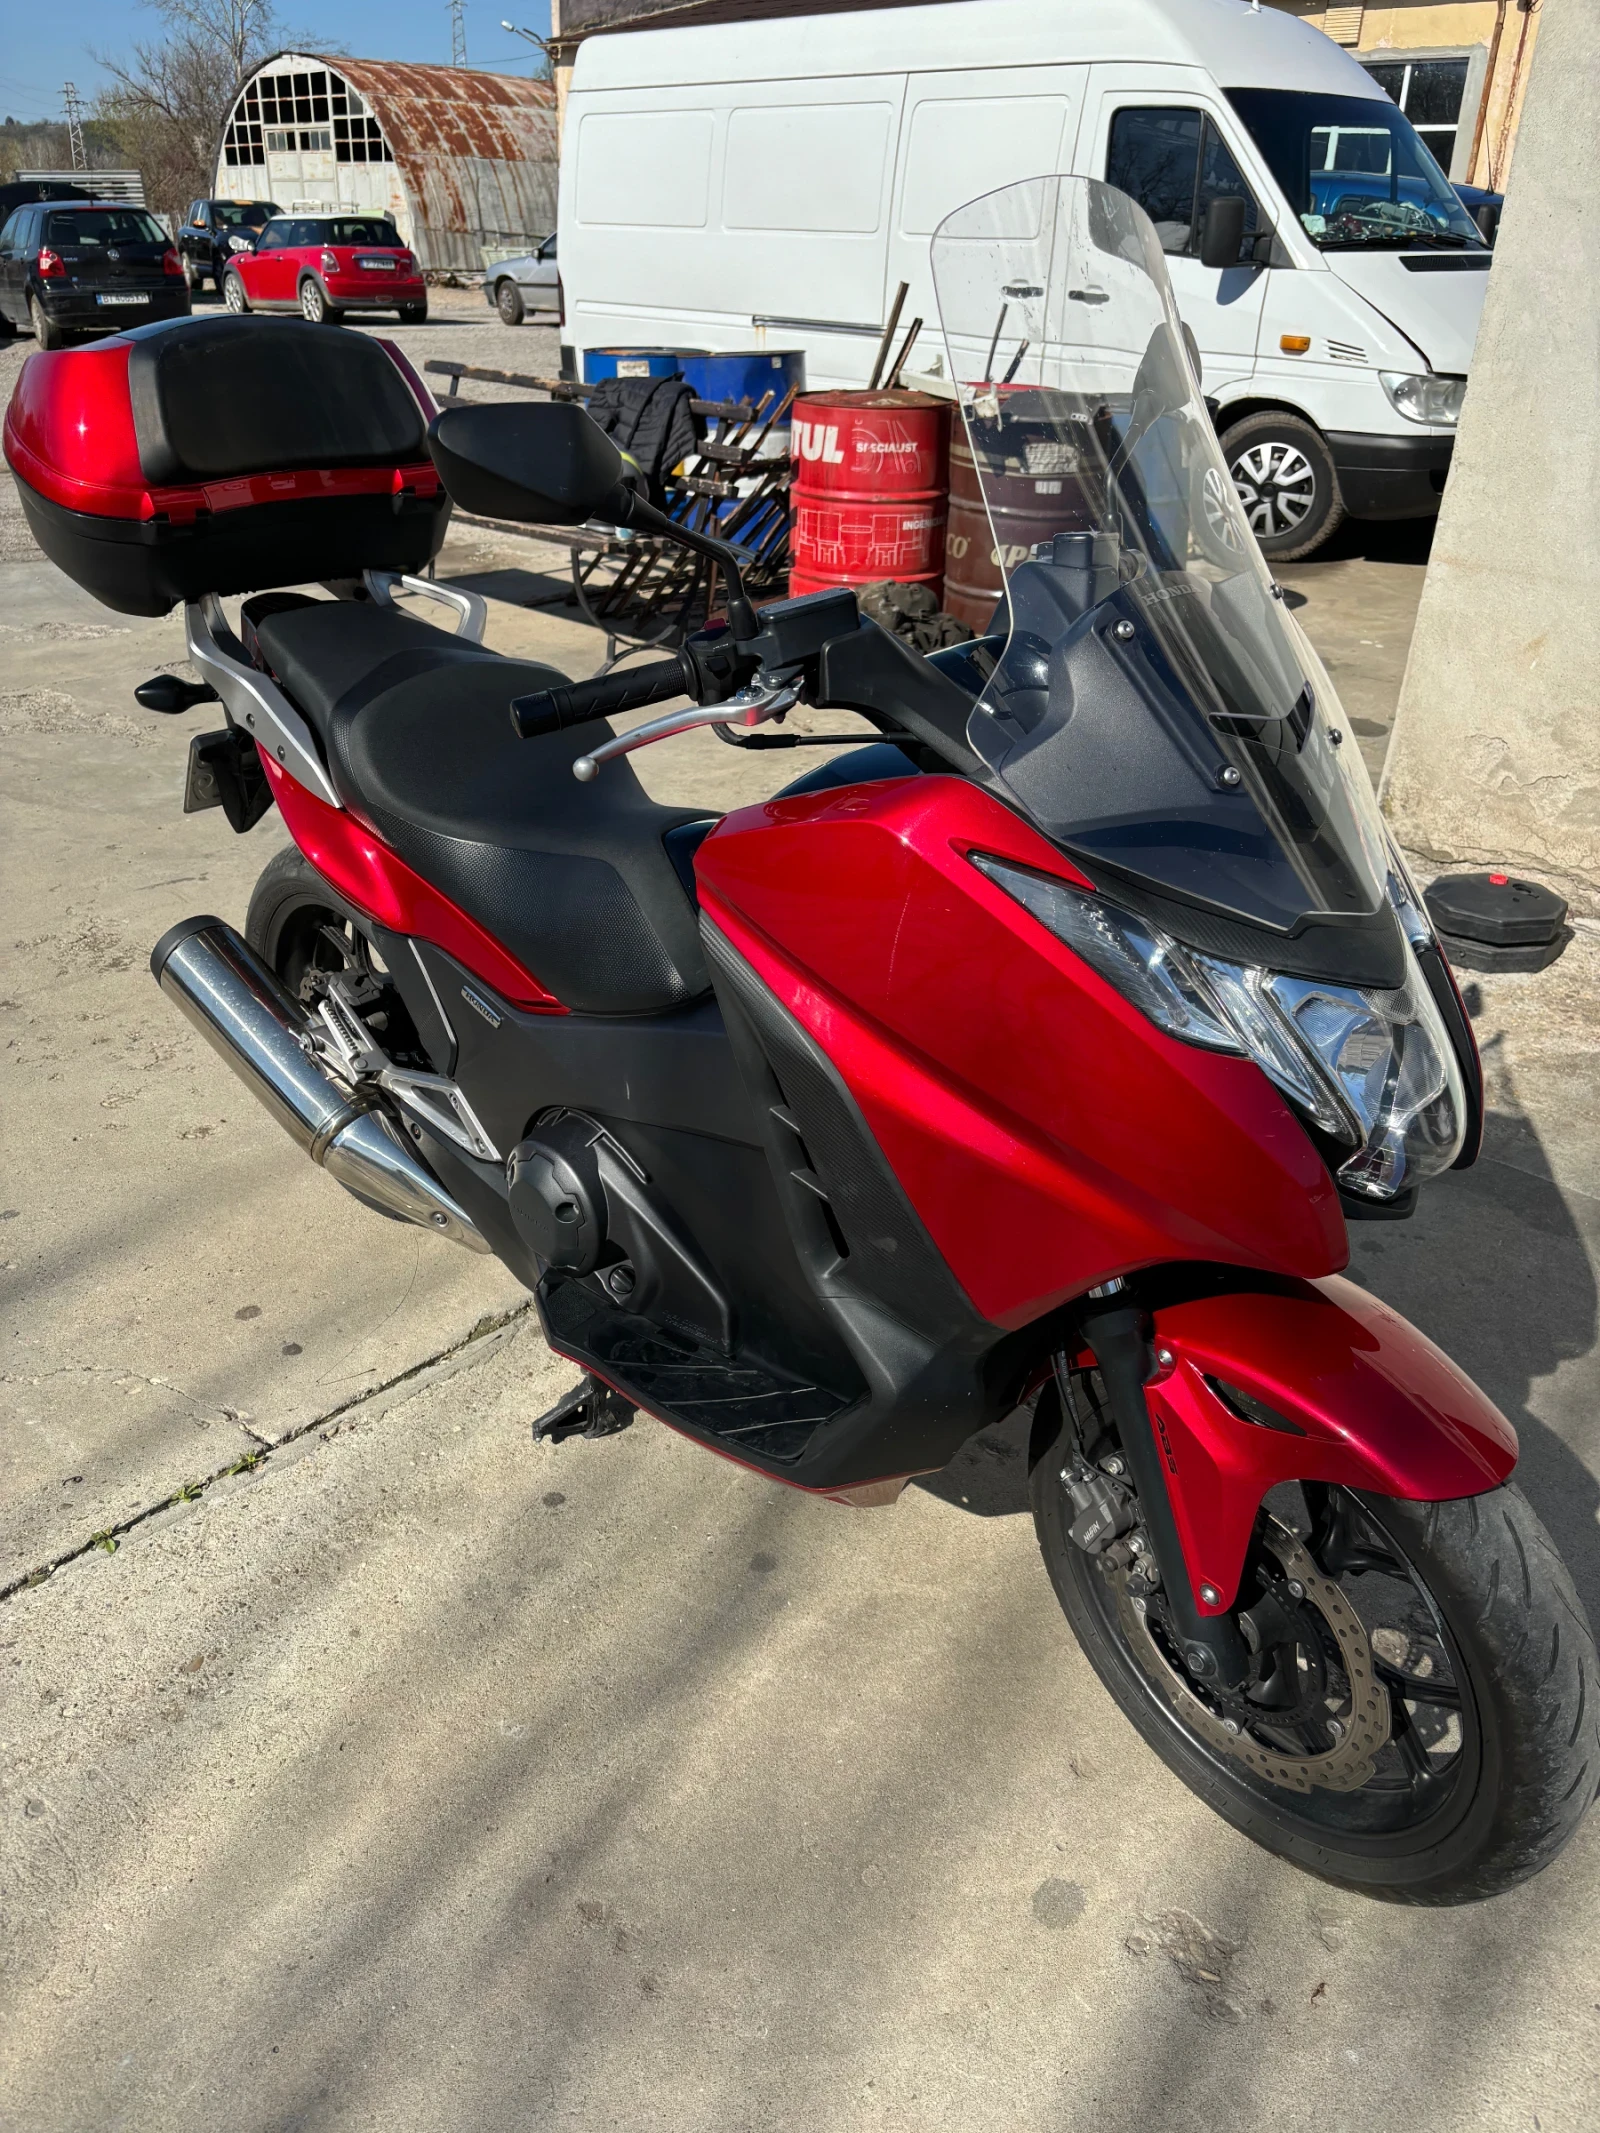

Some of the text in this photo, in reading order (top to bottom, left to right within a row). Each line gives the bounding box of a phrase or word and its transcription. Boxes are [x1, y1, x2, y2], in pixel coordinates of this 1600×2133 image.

[791, 418, 845, 464] TUL
[855, 442, 918, 455] SPECIALIST
[1141, 583, 1203, 606] HONDA
[465, 991, 496, 1023] HONDA
[1154, 1411, 1179, 1477] ABS
